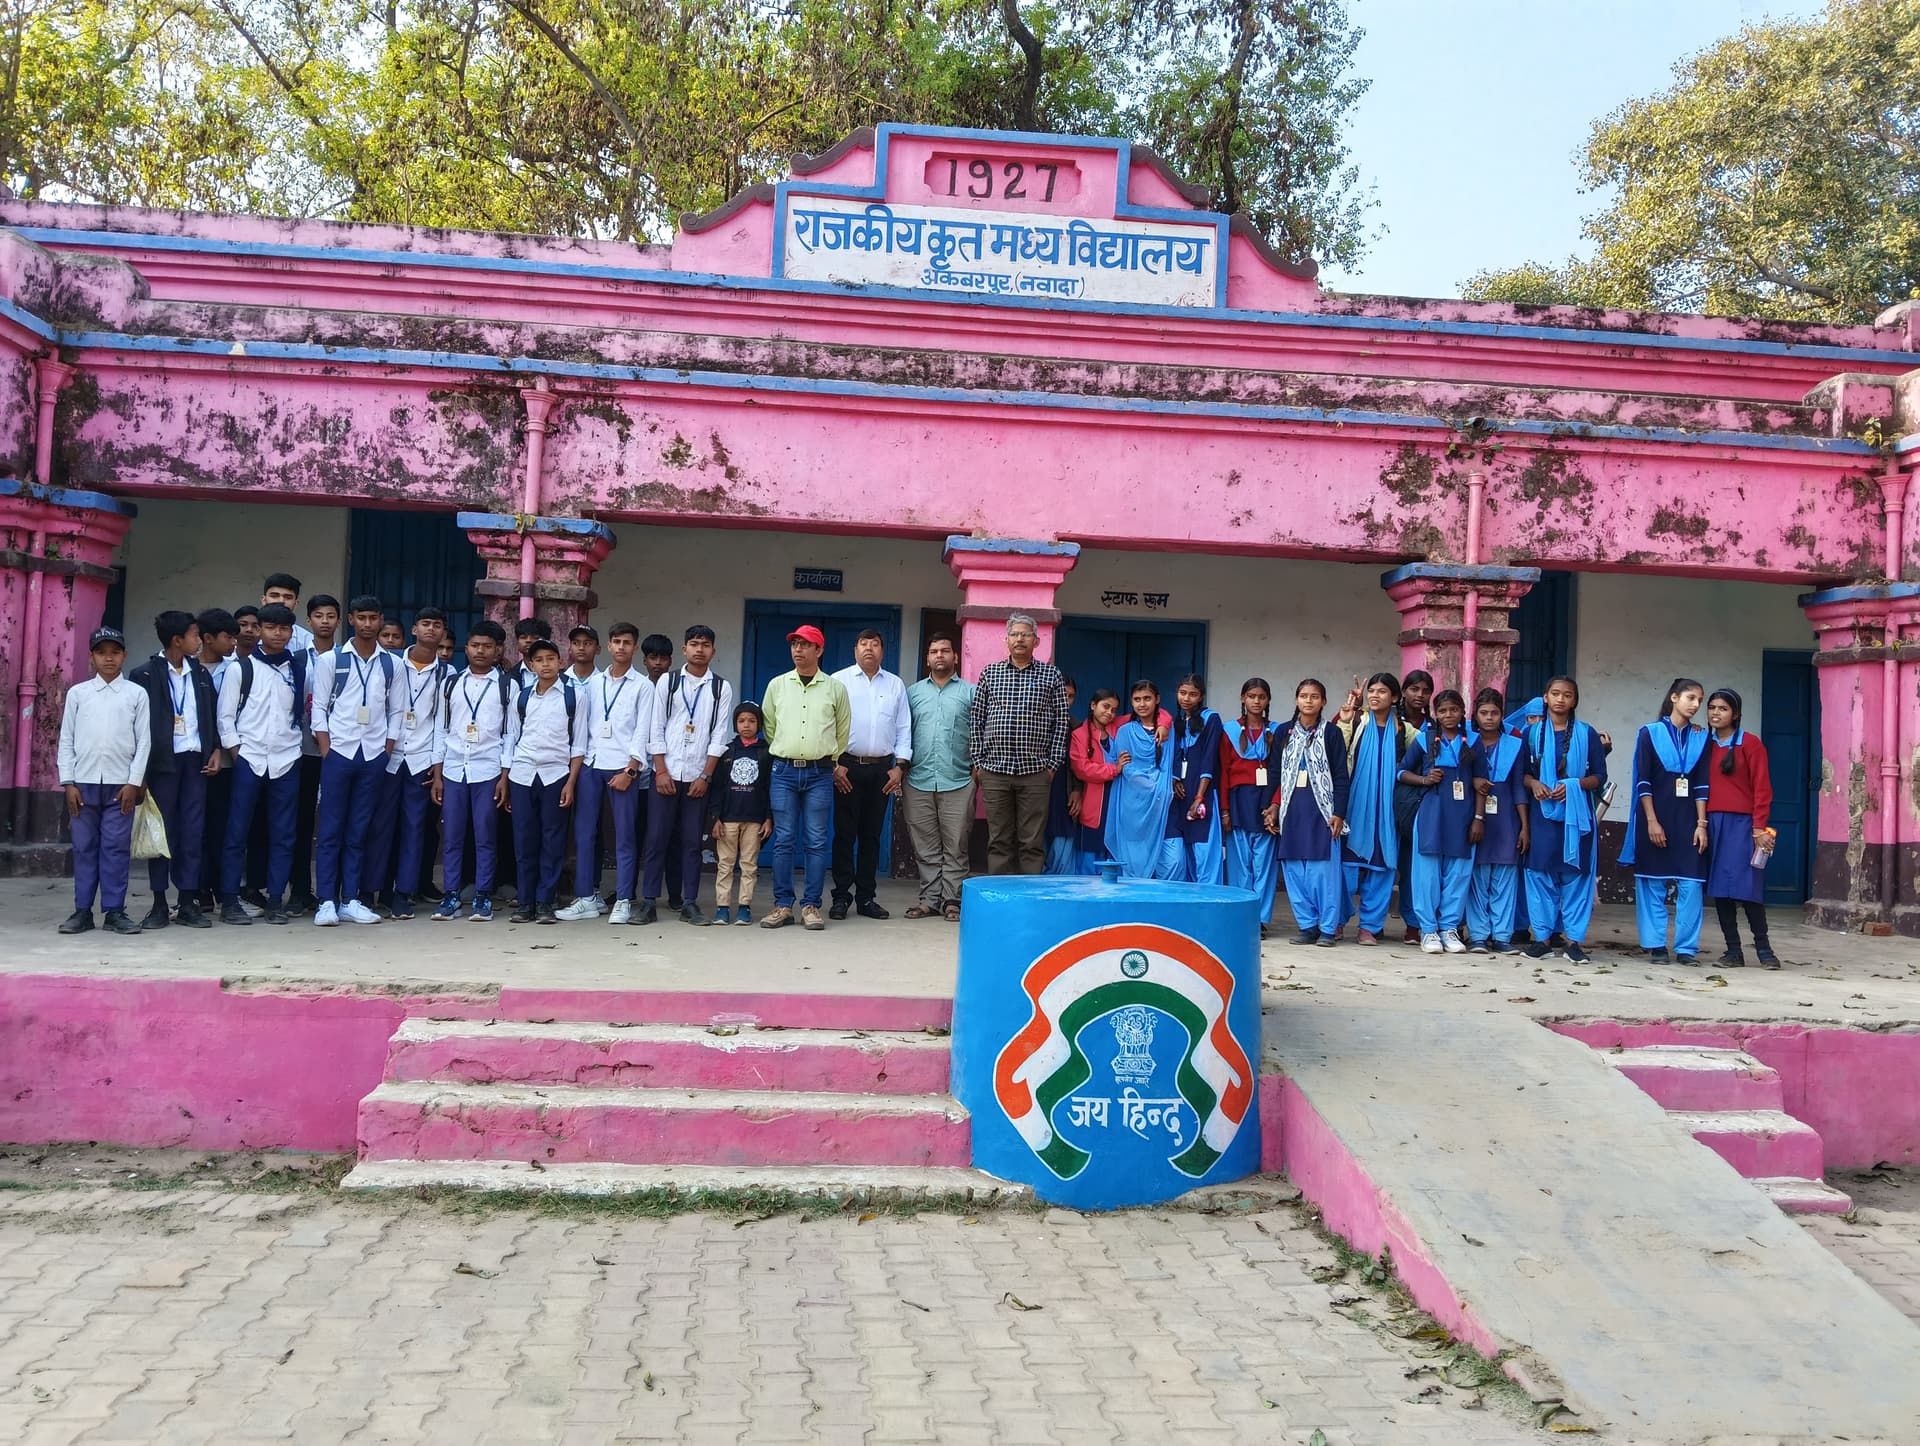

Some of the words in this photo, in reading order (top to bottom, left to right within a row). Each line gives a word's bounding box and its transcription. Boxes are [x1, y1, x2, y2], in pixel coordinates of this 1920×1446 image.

[946, 159, 1059, 203] 1927
[792, 204, 927, 256] राजकीय
[928, 219, 987, 271] कृत
[989, 223, 1064, 265] मध्य
[1065, 219, 1211, 275] विद्यालय
[795, 570, 841, 585] कार्यालय
[1101, 590, 1139, 609] स्टाफ
[1066, 1096, 1112, 1129] जय
[1117, 1086, 1185, 1147] हिन्द
